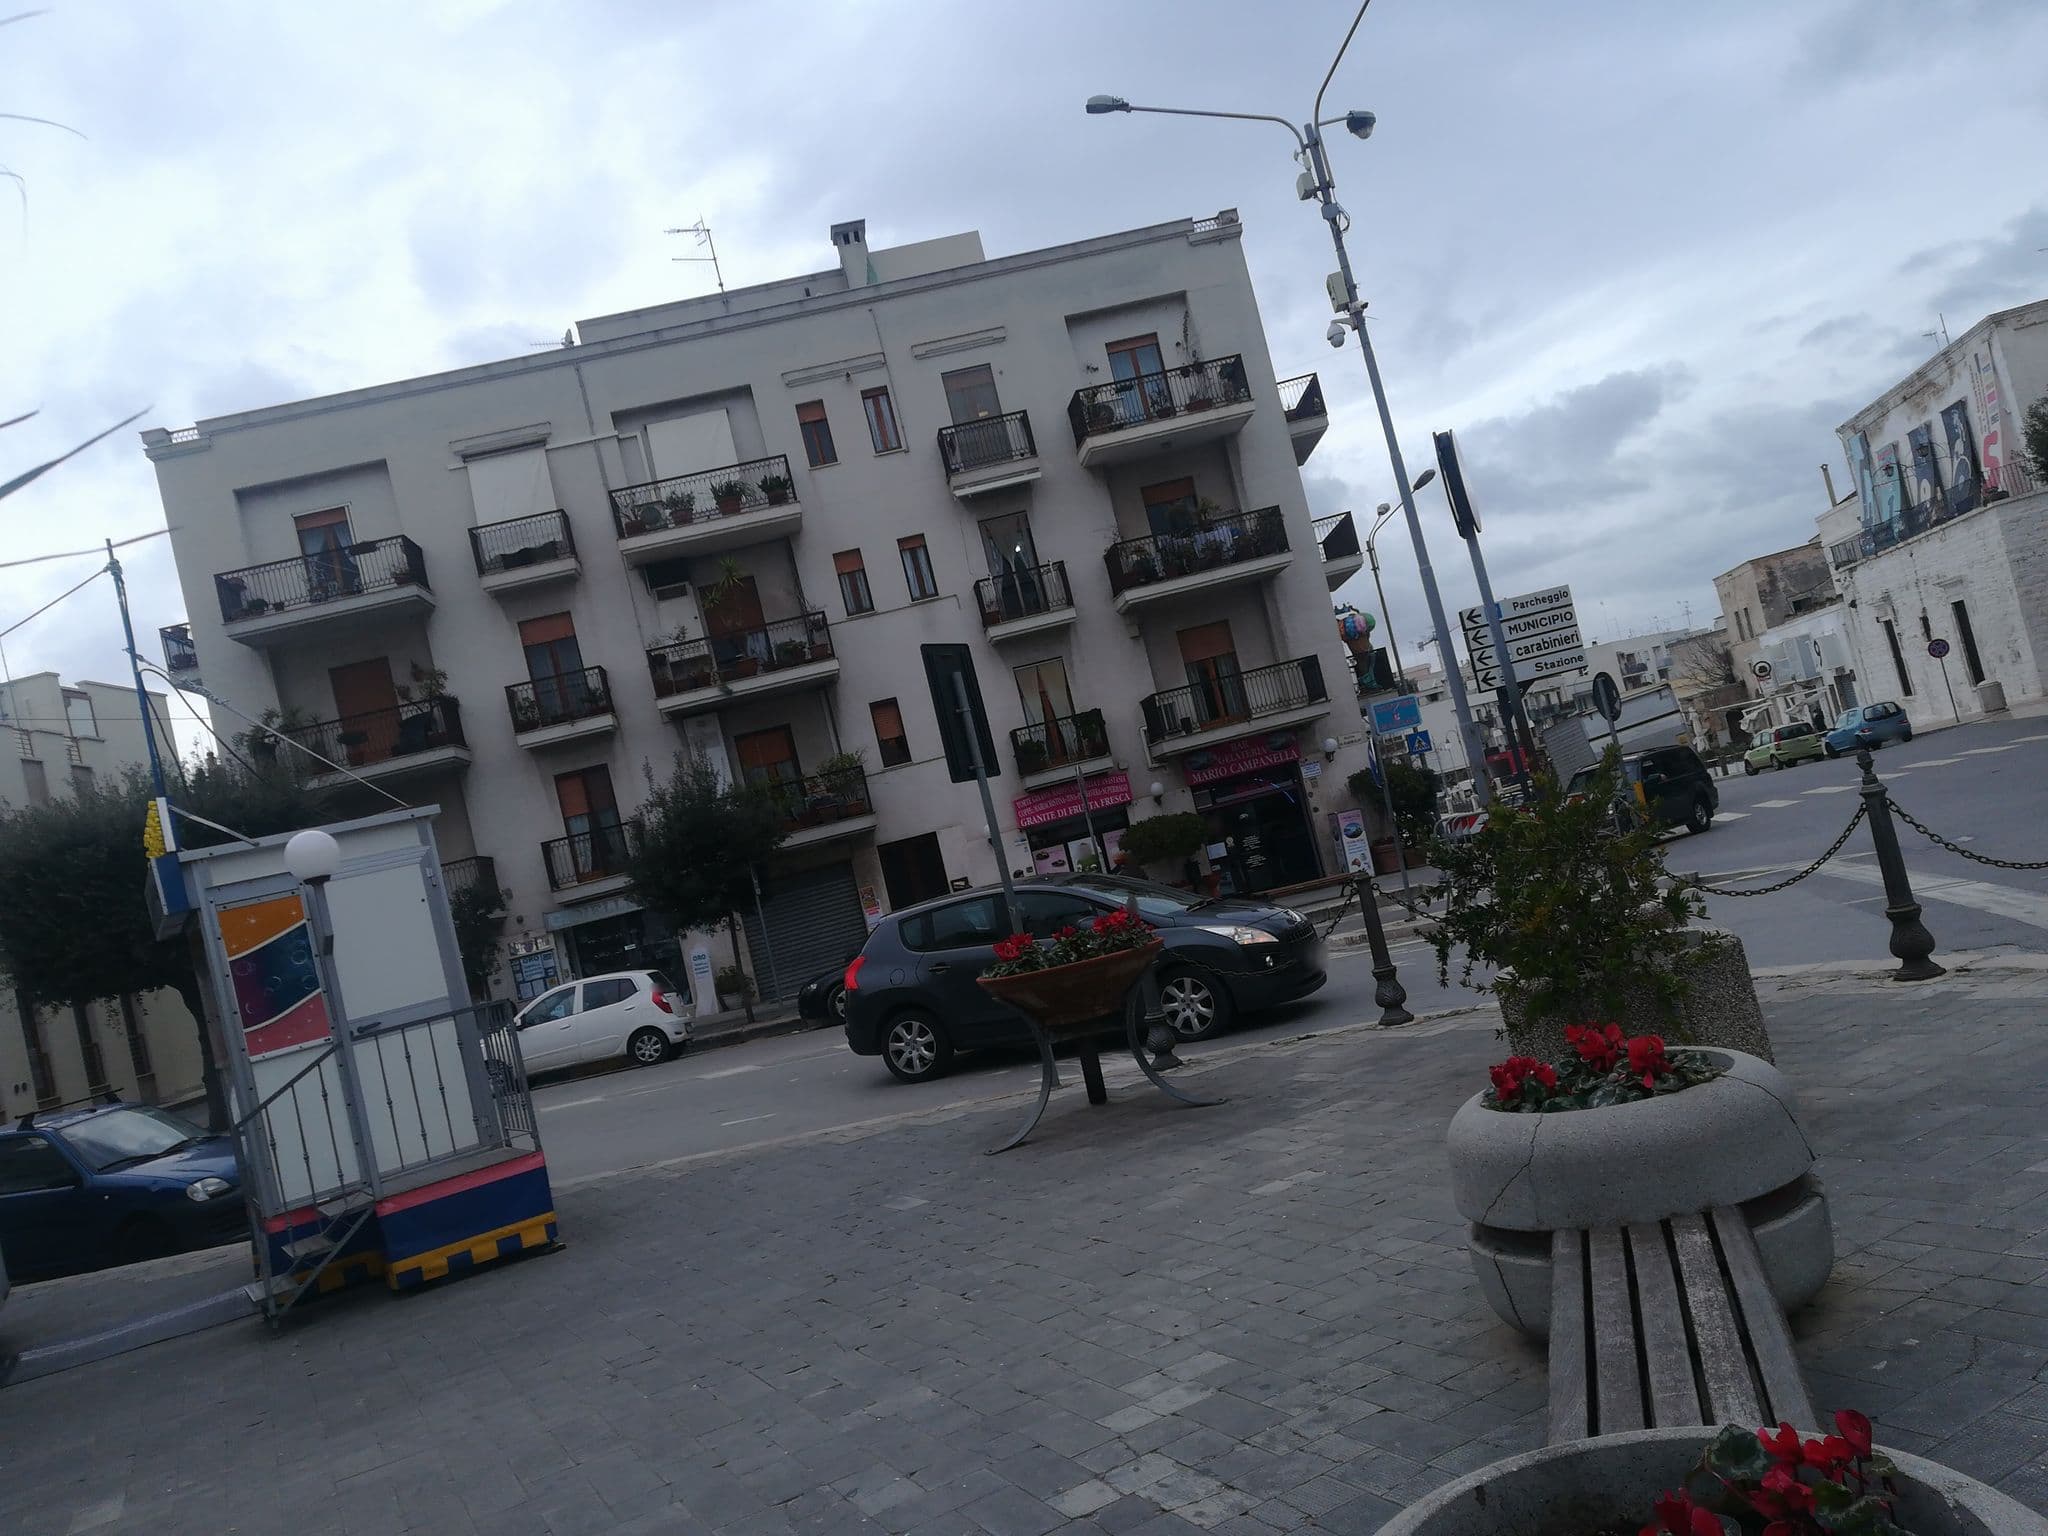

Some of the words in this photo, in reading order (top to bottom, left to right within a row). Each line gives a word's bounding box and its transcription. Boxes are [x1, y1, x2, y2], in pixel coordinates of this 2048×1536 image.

[1512, 589, 1569, 611] Parcheggio
[1508, 611, 1573, 635] MUNICIPIO
[1516, 630, 1580, 656] carabinieri
[1535, 653, 1584, 672] Stazione
[1191, 766, 1228, 783] MARIO
[1229, 749, 1299, 774] CAMPANELLA
[1020, 812, 1057, 827] GRANITE
[1057, 808, 1067, 818] DI
[1069, 800, 1100, 815] FRUTA
[1100, 793, 1131, 809] FRESCA
